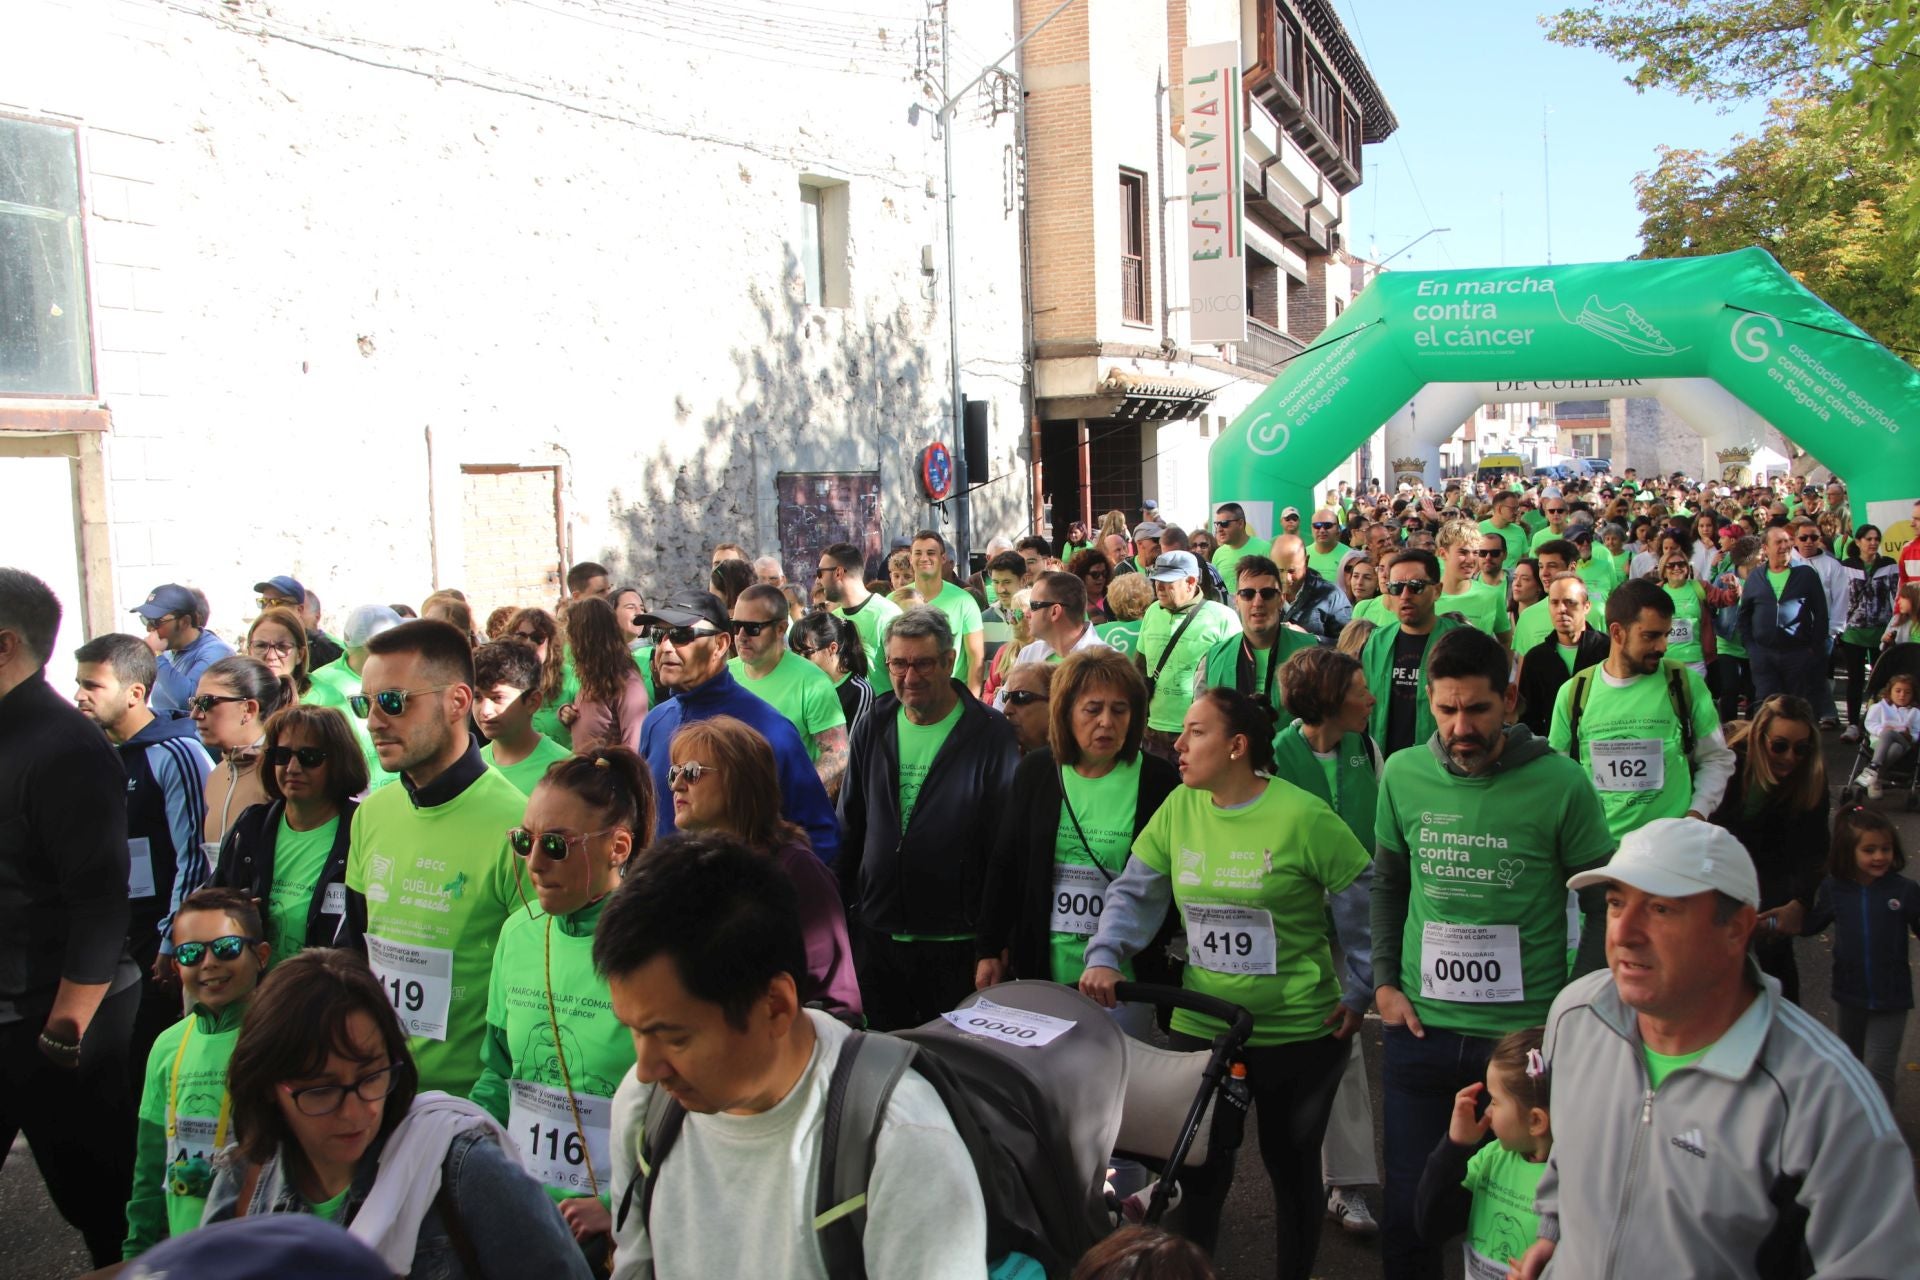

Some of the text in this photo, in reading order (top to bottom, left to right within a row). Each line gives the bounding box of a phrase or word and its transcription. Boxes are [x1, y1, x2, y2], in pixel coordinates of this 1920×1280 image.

[1417, 277, 1554, 297] En marcha
[1192, 294, 1241, 314] DISCO
[1414, 300, 1497, 321] contra
[1415, 324, 1535, 347] el cáncer
[1279, 362, 1326, 408] asociación
[1496, 380, 1527, 392] DE
[1768, 367, 1831, 423] en Segovia
[1777, 355, 1866, 428] contra el cáncer
[1788, 344, 1900, 434] asociación española
[1287, 388, 1317, 417] contra
[1316, 378, 1327, 390] el
[1295, 376, 1350, 427] en Segovia
[1885, 541, 1909, 552] uv
[1608, 759, 1647, 777] 162
[1419, 828, 1508, 849] En marcha
[416, 857, 446, 872] aecc
[1229, 850, 1257, 861] aecc
[1418, 846, 1470, 863] contra
[1421, 860, 1495, 880] el cáncer
[1058, 892, 1104, 917] 900
[1203, 931, 1253, 956] 419
[1435, 957, 1501, 983] 0000
[512, 986, 540, 998] MARCHA
[542, 991, 573, 1003] CELLAR
[568, 1008, 596, 1019] cáncer
[969, 1018, 1037, 1039] 0000
[558, 1102, 565, 1110] el
[530, 1122, 586, 1166] 116
